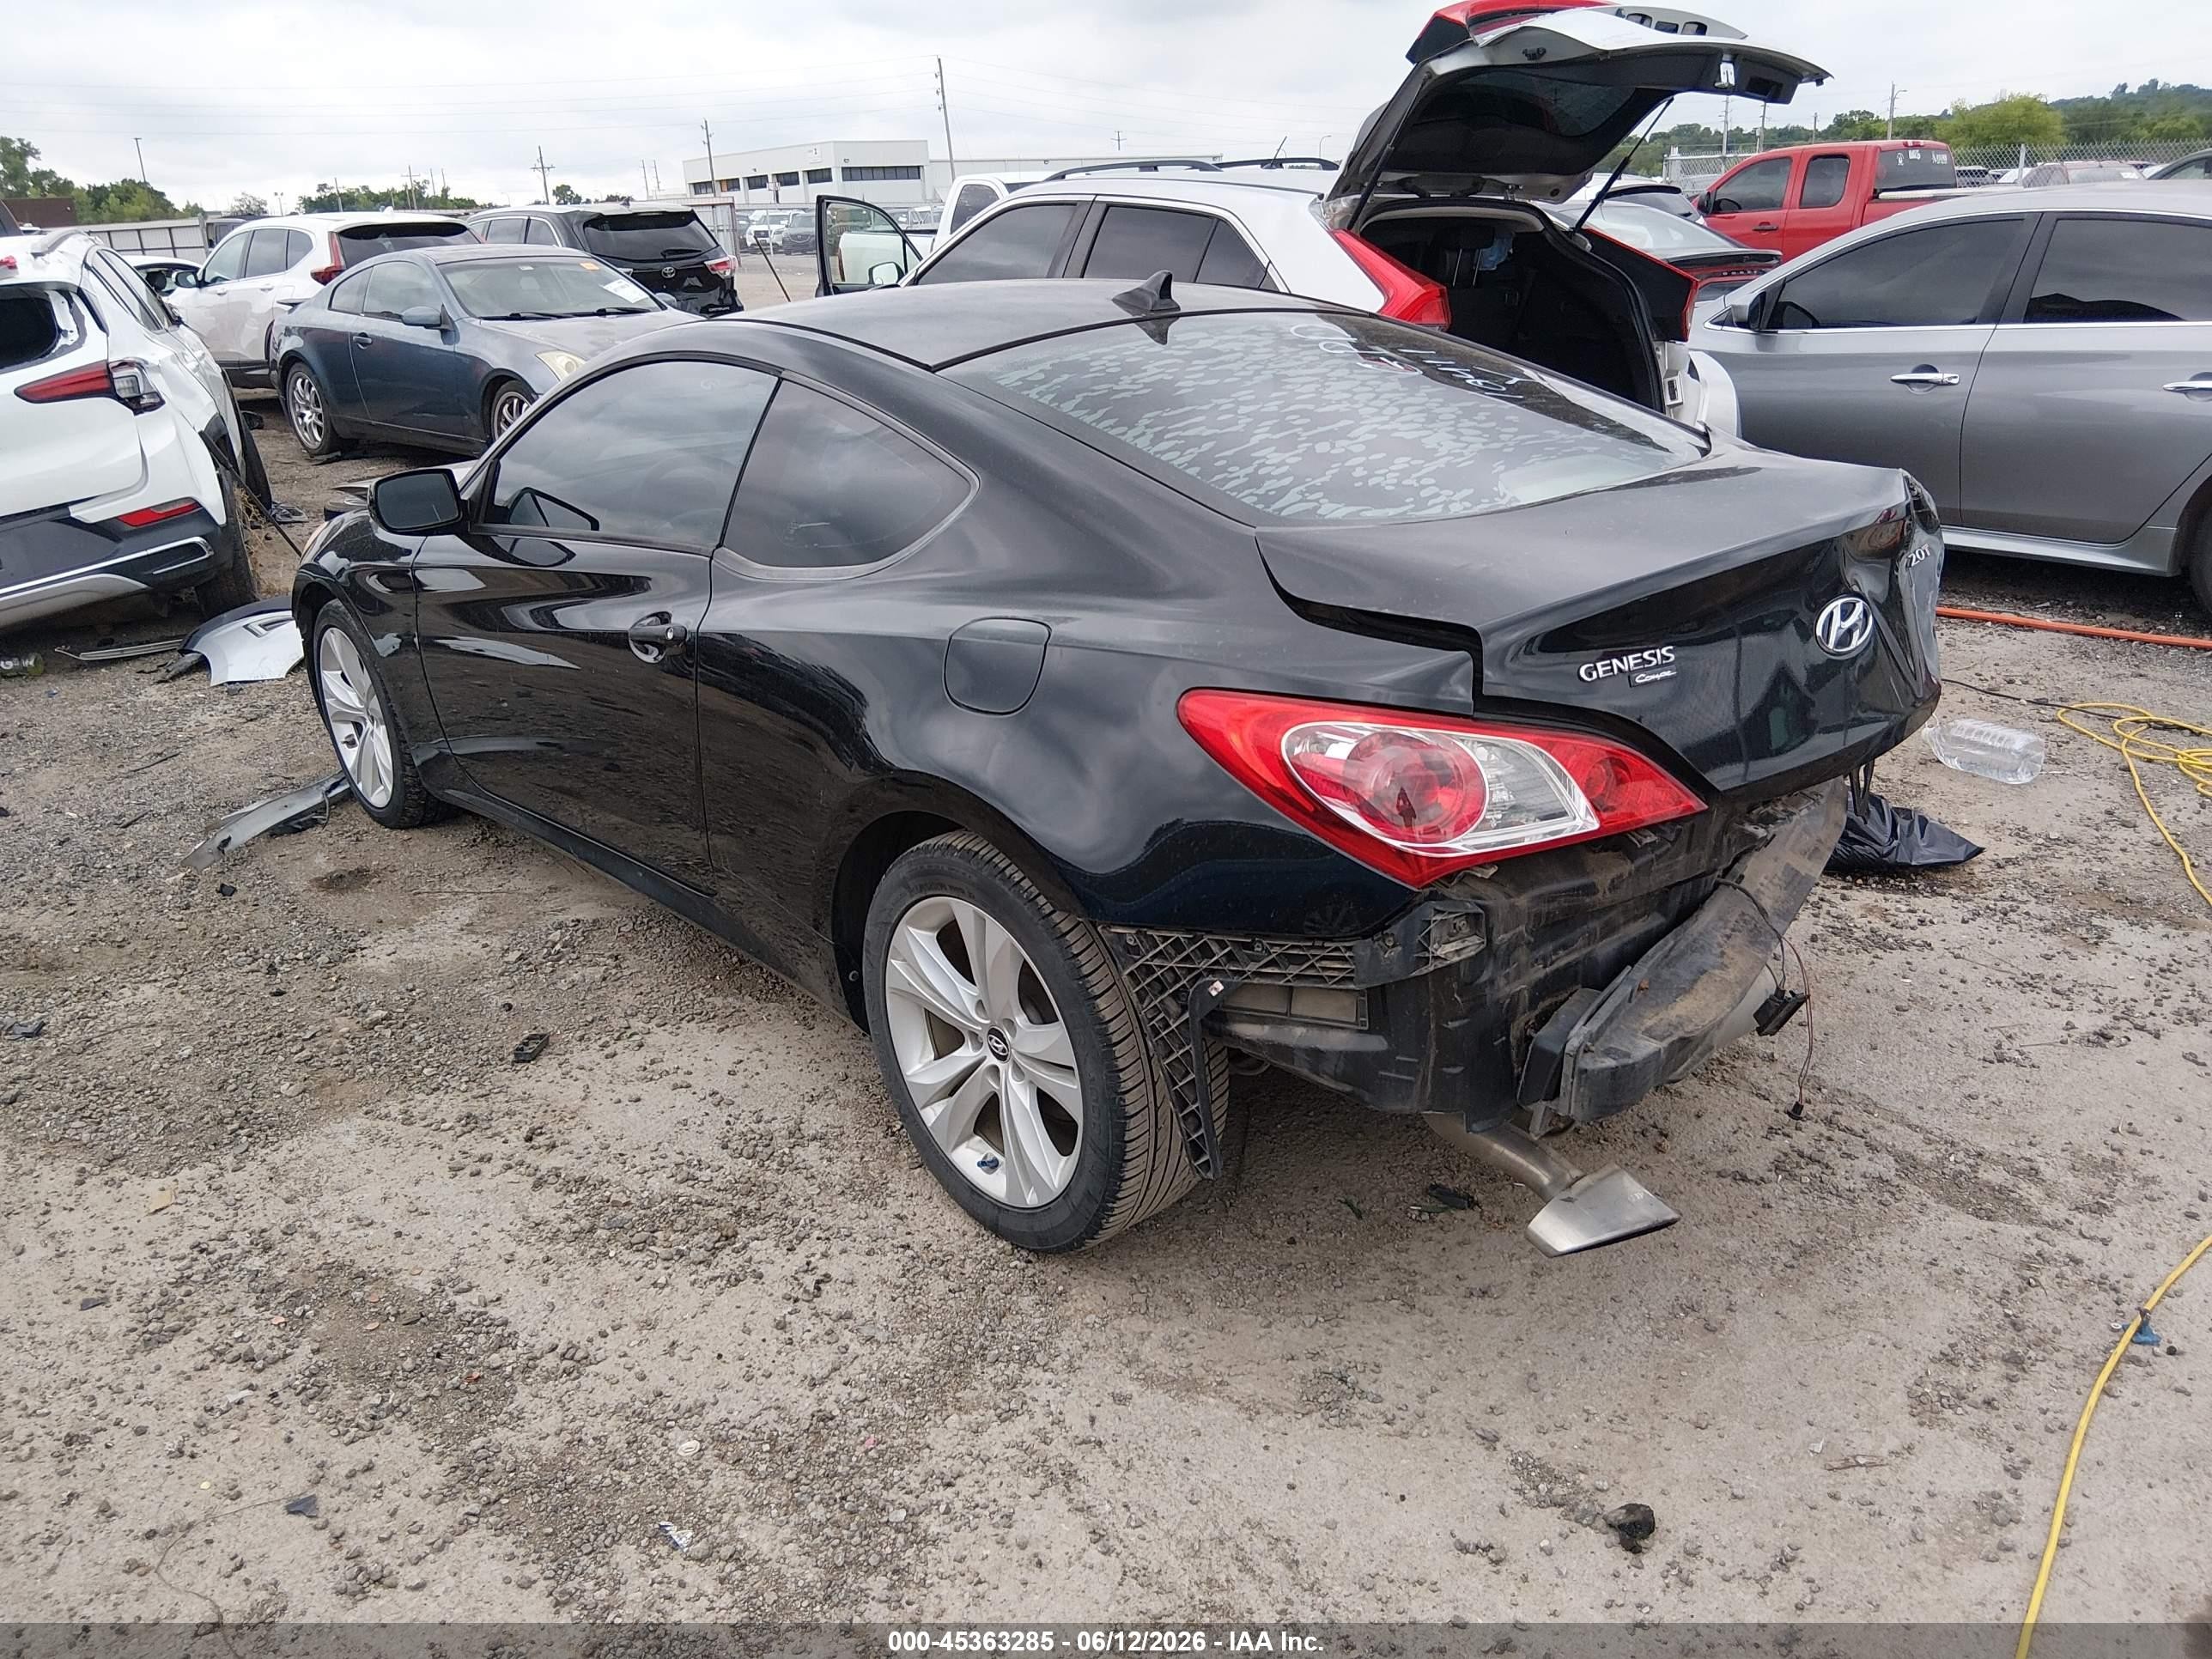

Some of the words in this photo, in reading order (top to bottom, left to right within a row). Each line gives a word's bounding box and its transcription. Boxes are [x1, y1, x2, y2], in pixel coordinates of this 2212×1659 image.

[1907, 543, 1931, 567] 20T
[1578, 645, 1675, 682] GENESIS
[1634, 669, 1677, 684] Coupe
